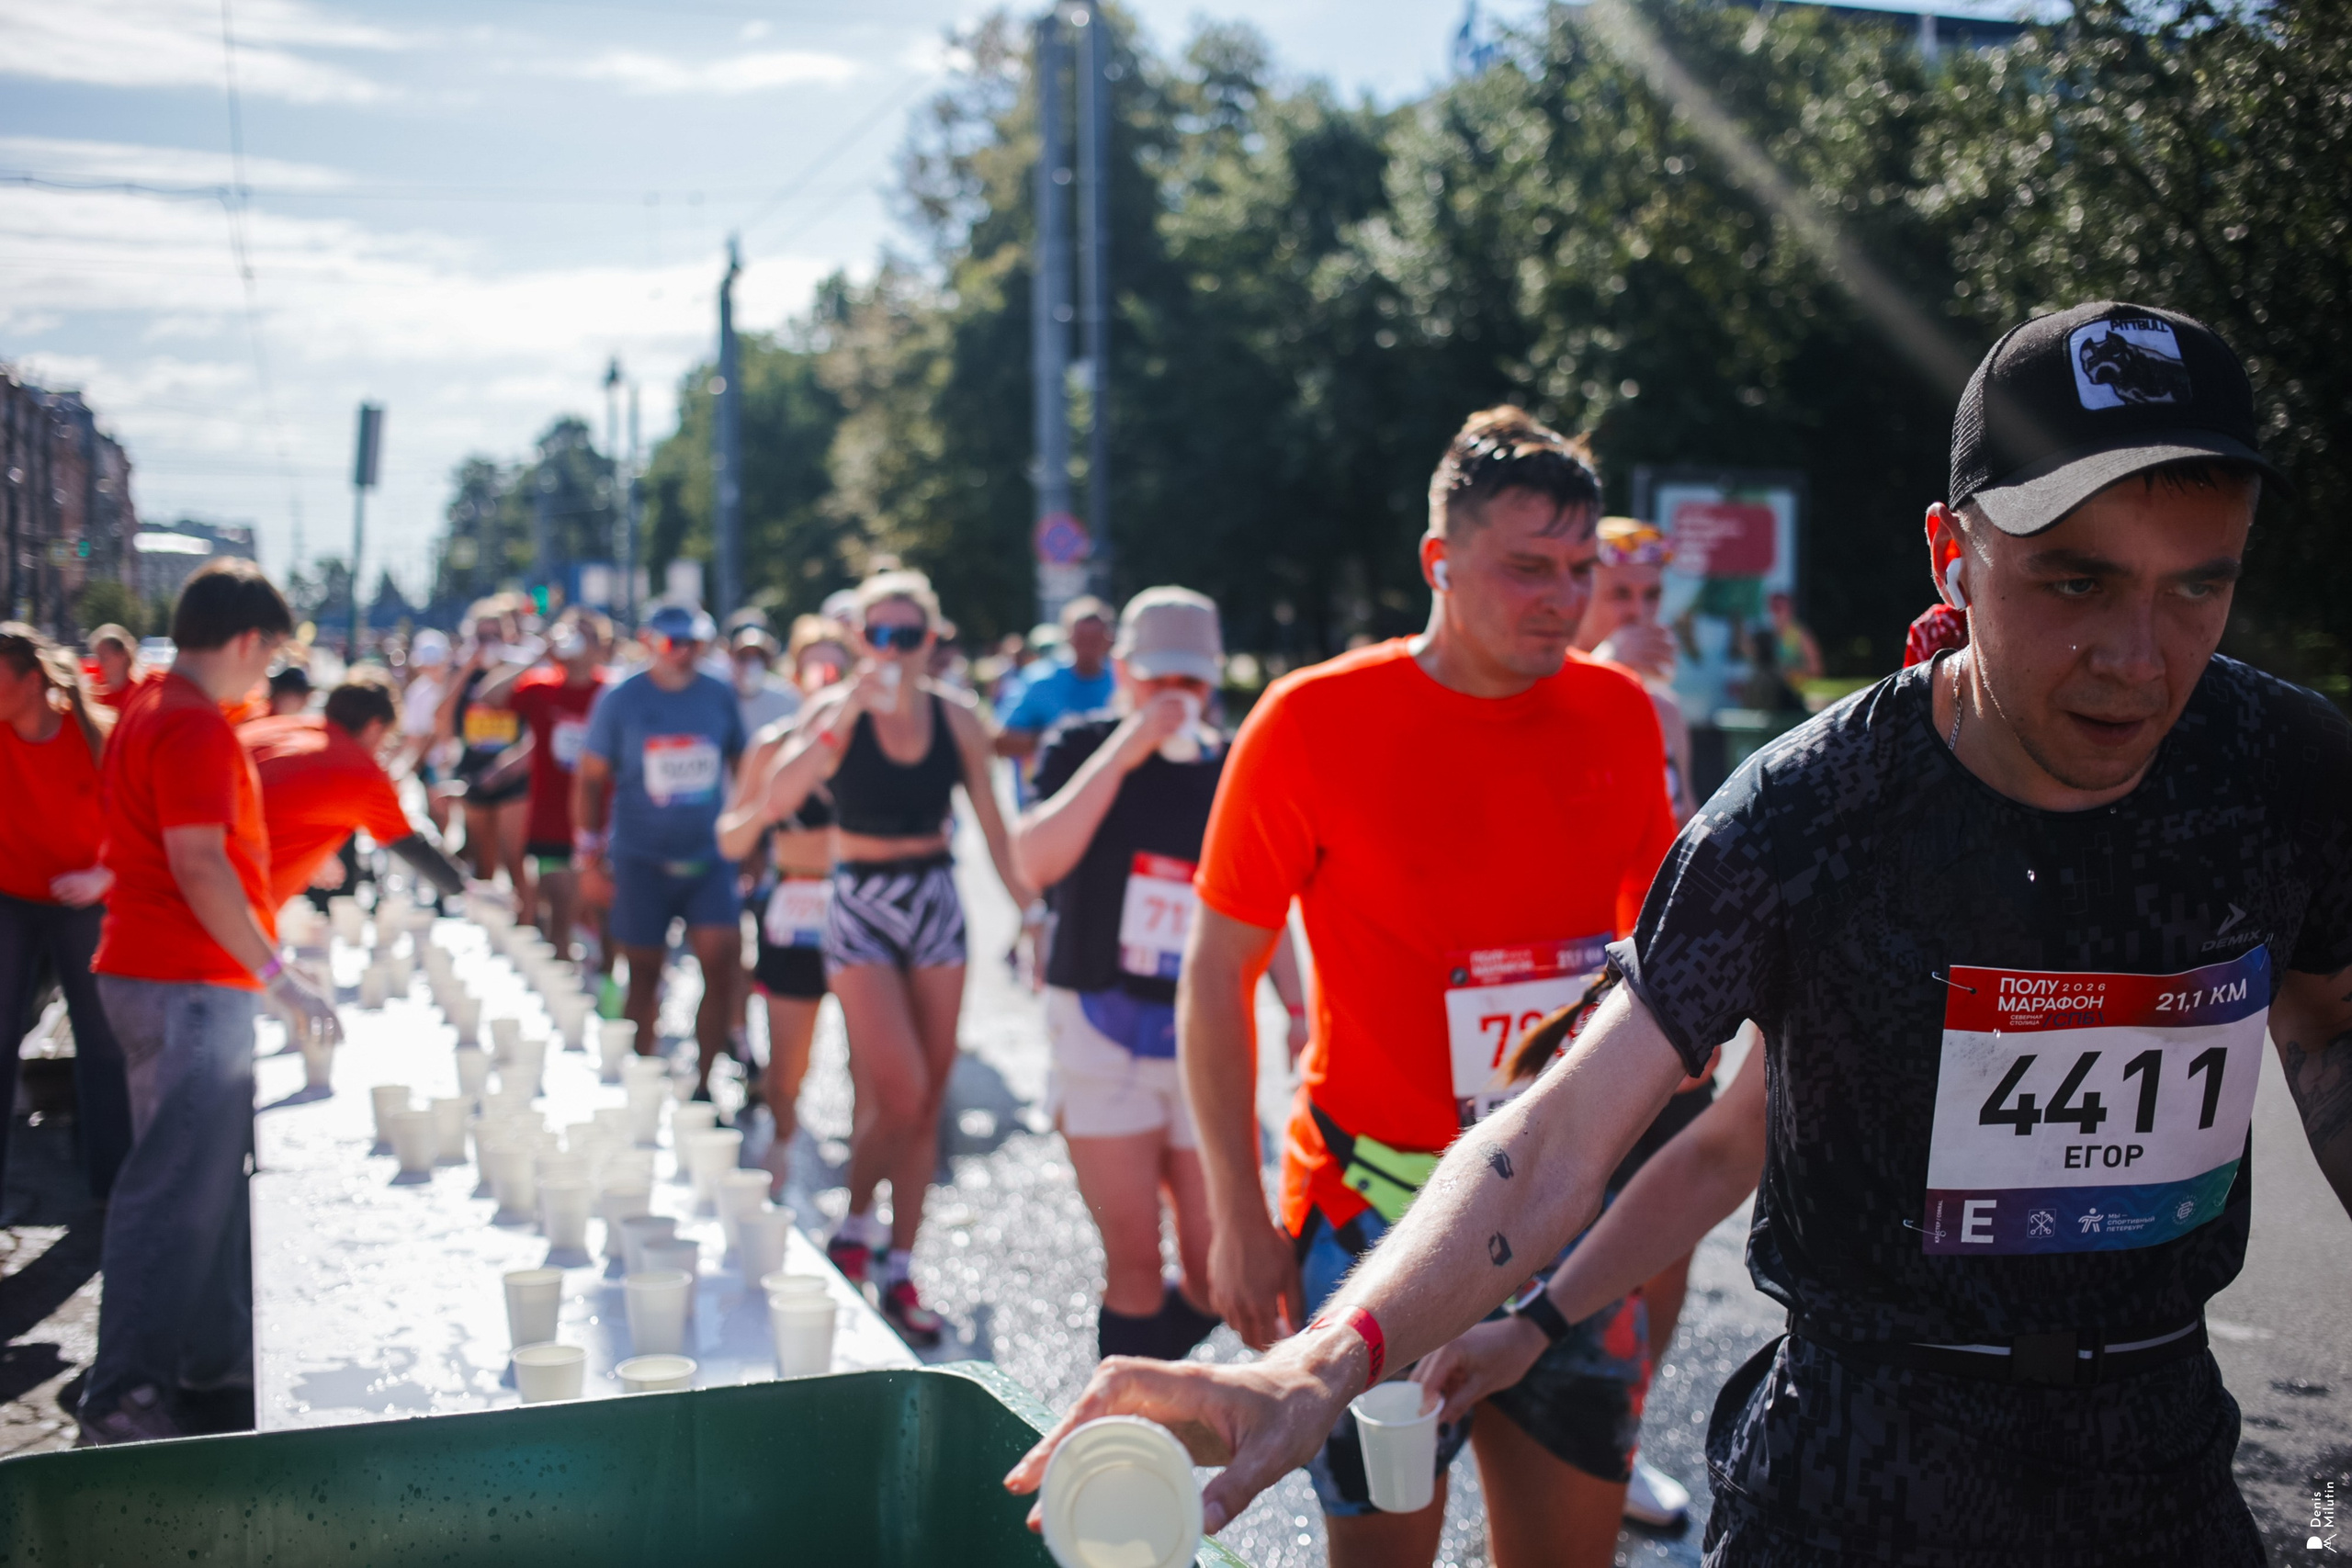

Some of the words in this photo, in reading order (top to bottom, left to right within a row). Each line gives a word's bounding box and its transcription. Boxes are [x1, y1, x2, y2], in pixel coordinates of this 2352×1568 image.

[2110, 319, 2169, 333] PITTBULL
[2200, 929, 2262, 953] DEMIX
[1999, 976, 2060, 995] ПОЛУ
[2062, 983, 2107, 992] 2026
[2154, 989, 2203, 1013] 21,1
[2209, 977, 2247, 1006] КМ
[1996, 995, 2105, 1012] МАРАФОН
[1978, 1046, 2228, 1137] 4411
[2064, 1145, 2144, 1169] ЕГОР
[1961, 1200, 1997, 1244] E
[2106, 1224, 2145, 1232] ПЕТЕРБУРГ
[2107, 1215, 2155, 1226] СПОРТИВНЫЙ
